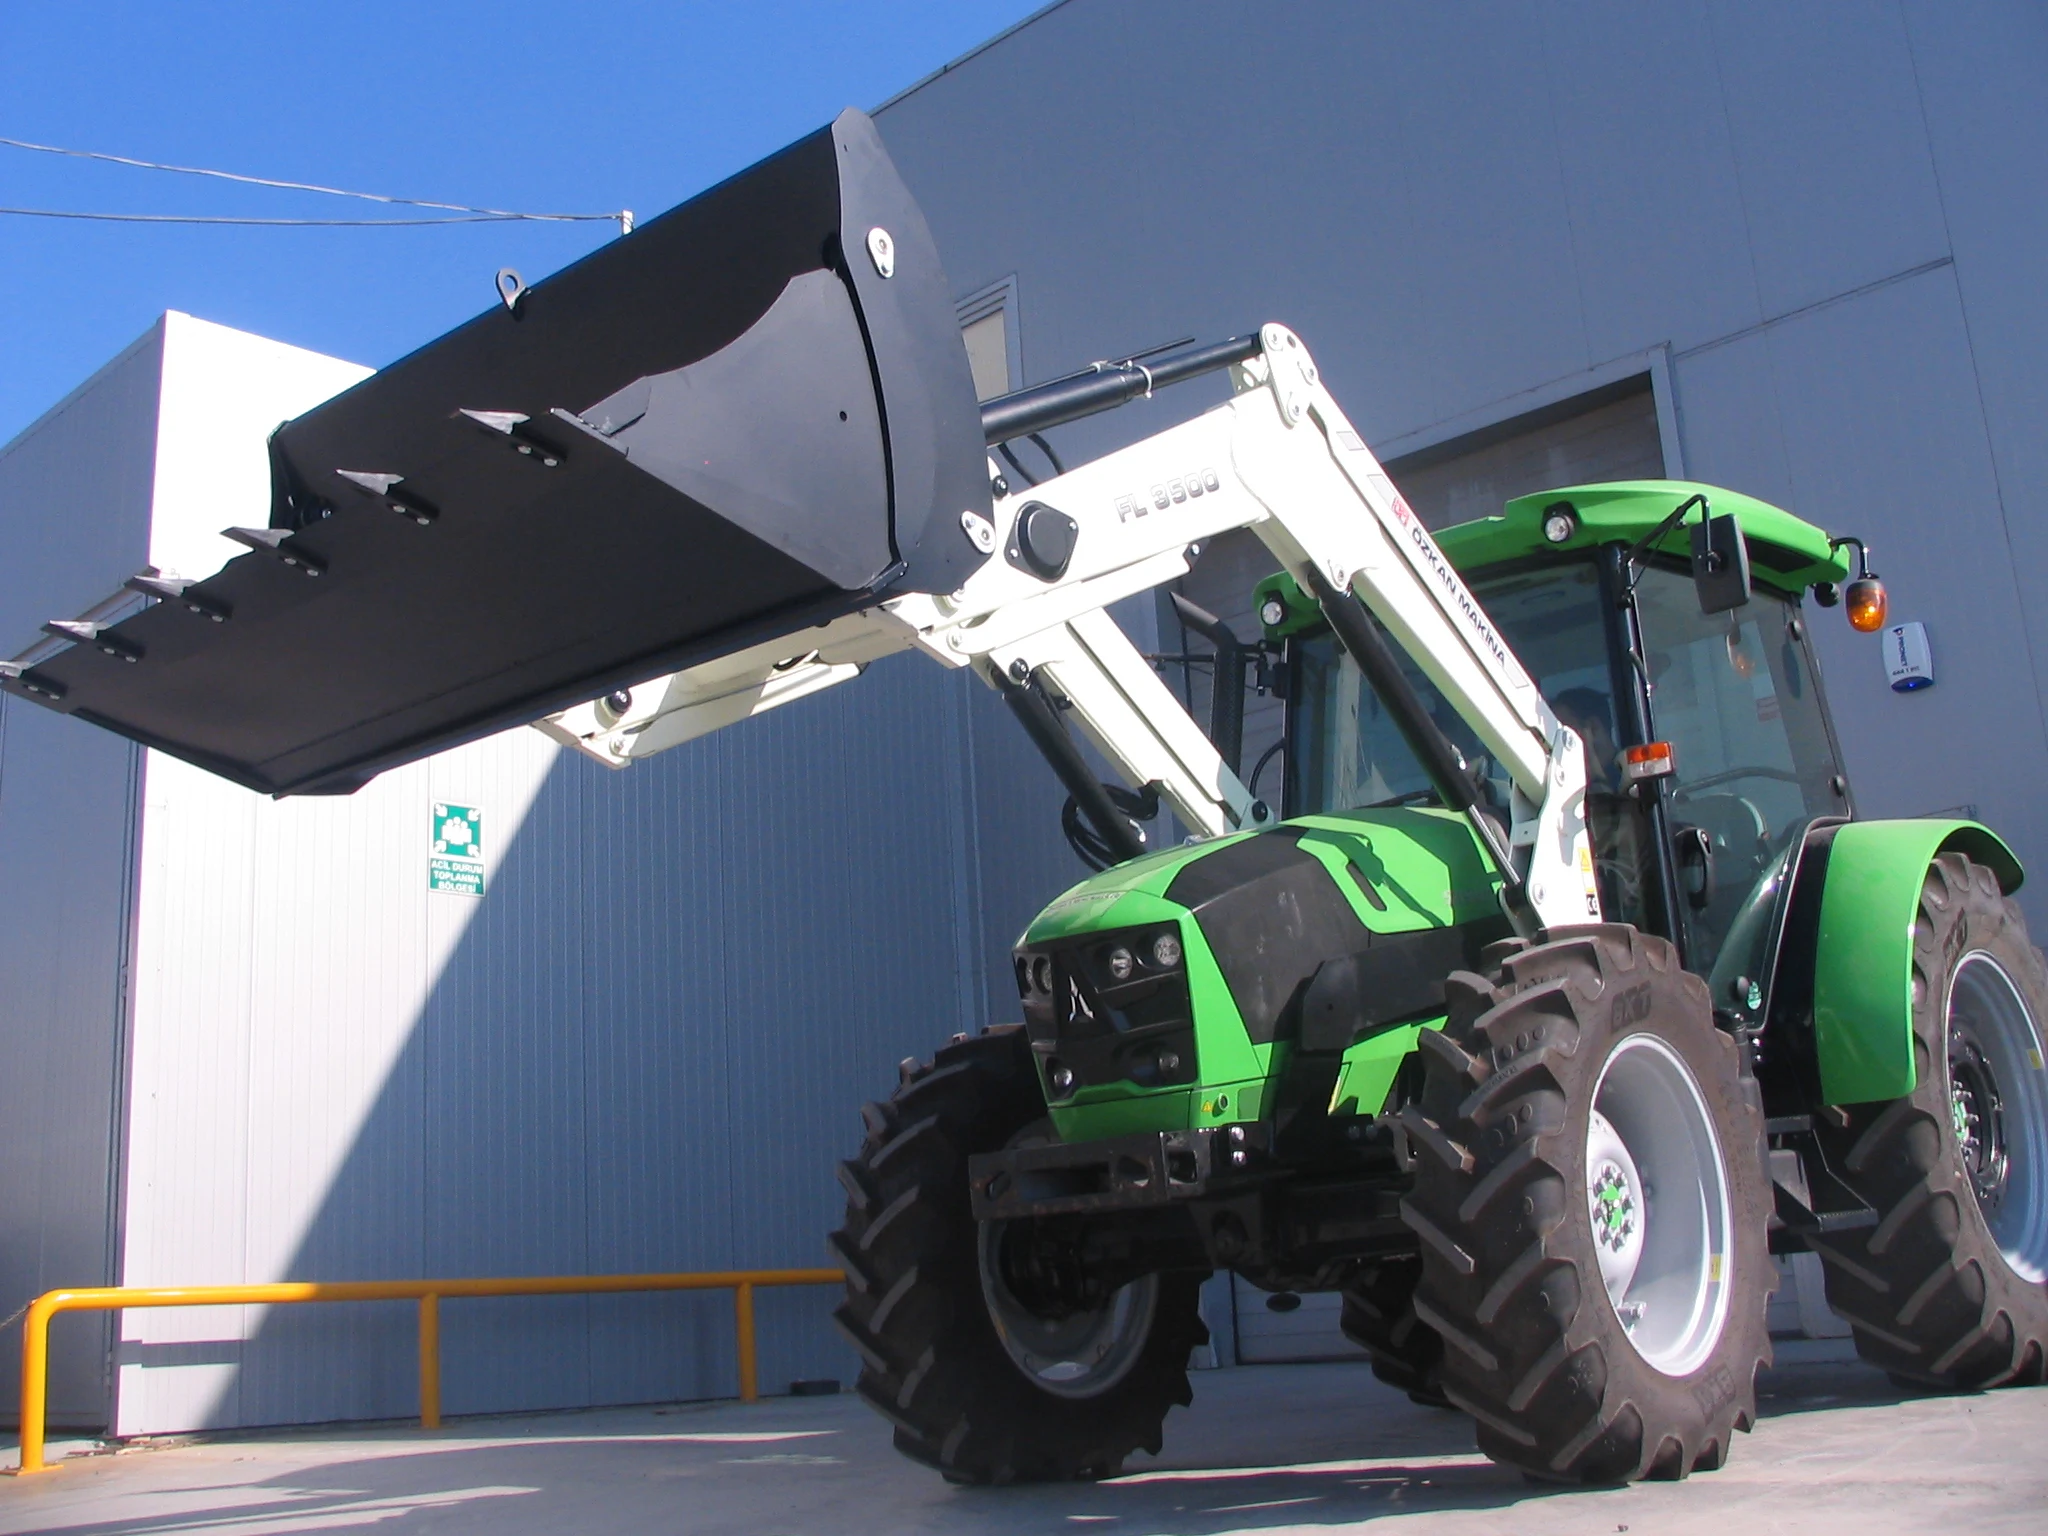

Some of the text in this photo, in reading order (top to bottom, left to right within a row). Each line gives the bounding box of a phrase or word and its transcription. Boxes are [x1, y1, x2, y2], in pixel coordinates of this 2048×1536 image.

[1114, 467, 1219, 523] FL 3500
[1412, 526, 1505, 665] ÖZKAN MAKİNA
[433, 870, 480, 884] TOPLANMA
[452, 862, 483, 874] DURUM
